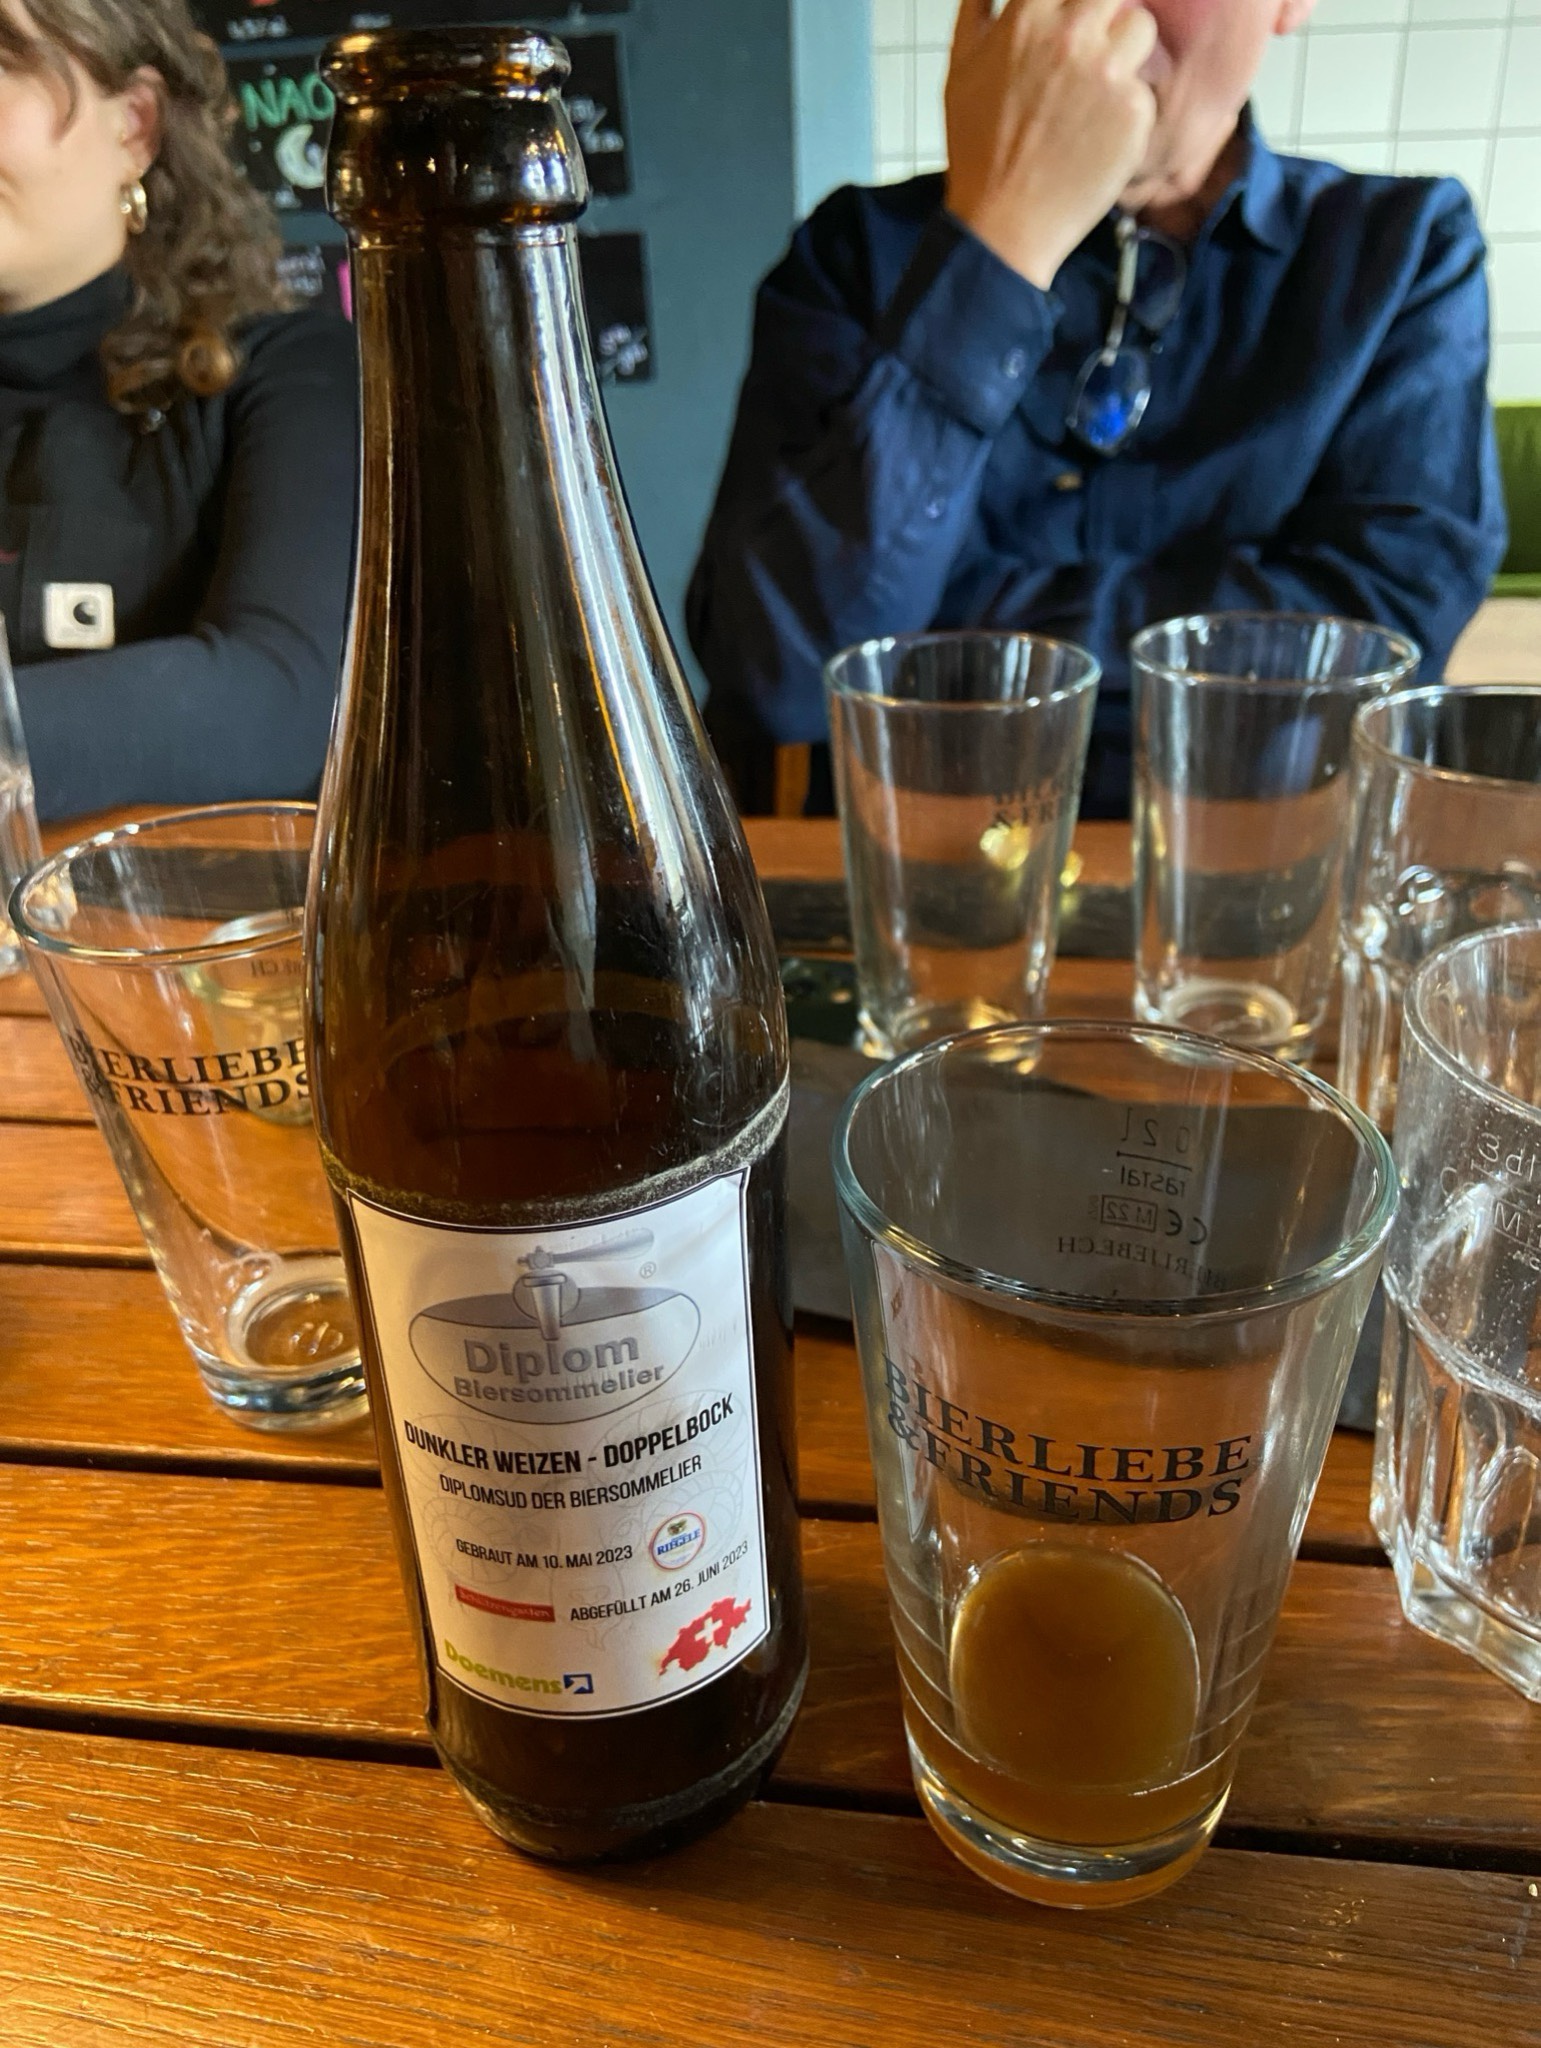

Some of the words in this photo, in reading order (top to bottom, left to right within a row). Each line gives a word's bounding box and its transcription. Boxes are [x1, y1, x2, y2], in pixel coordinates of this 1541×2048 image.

[453, 1363, 665, 1404] Biersommelier
[463, 1335, 639, 1384] Diplom
[404, 1420, 490, 1471] DUNKLER
[493, 1449, 582, 1475] WEIZEN
[603, 1393, 735, 1468] DOPPELBOCK
[882, 1353, 1253, 1484] BIERLIEBE
[439, 1474, 527, 1509] DIPLOMSUD
[532, 1492, 566, 1509] DER
[570, 1454, 703, 1508] BIERSOMMELIER
[922, 1426, 1243, 1525] FRIENDS
[456, 1538, 513, 1566] GEBRAUT
[516, 1551, 539, 1568] AM
[543, 1557, 564, 1569] 10.
[566, 1552, 593, 1568] MAI
[596, 1545, 634, 1565] 2023
[657, 1529, 701, 1555] RIEGELE
[570, 1595, 647, 1621] ABGEFÜLLT
[650, 1591, 672, 1607] AM
[674, 1578, 695, 1598] 26.
[697, 1561, 721, 1587] JUNI
[722, 1540, 749, 1571] 2023
[443, 1639, 562, 1694] Doemens
